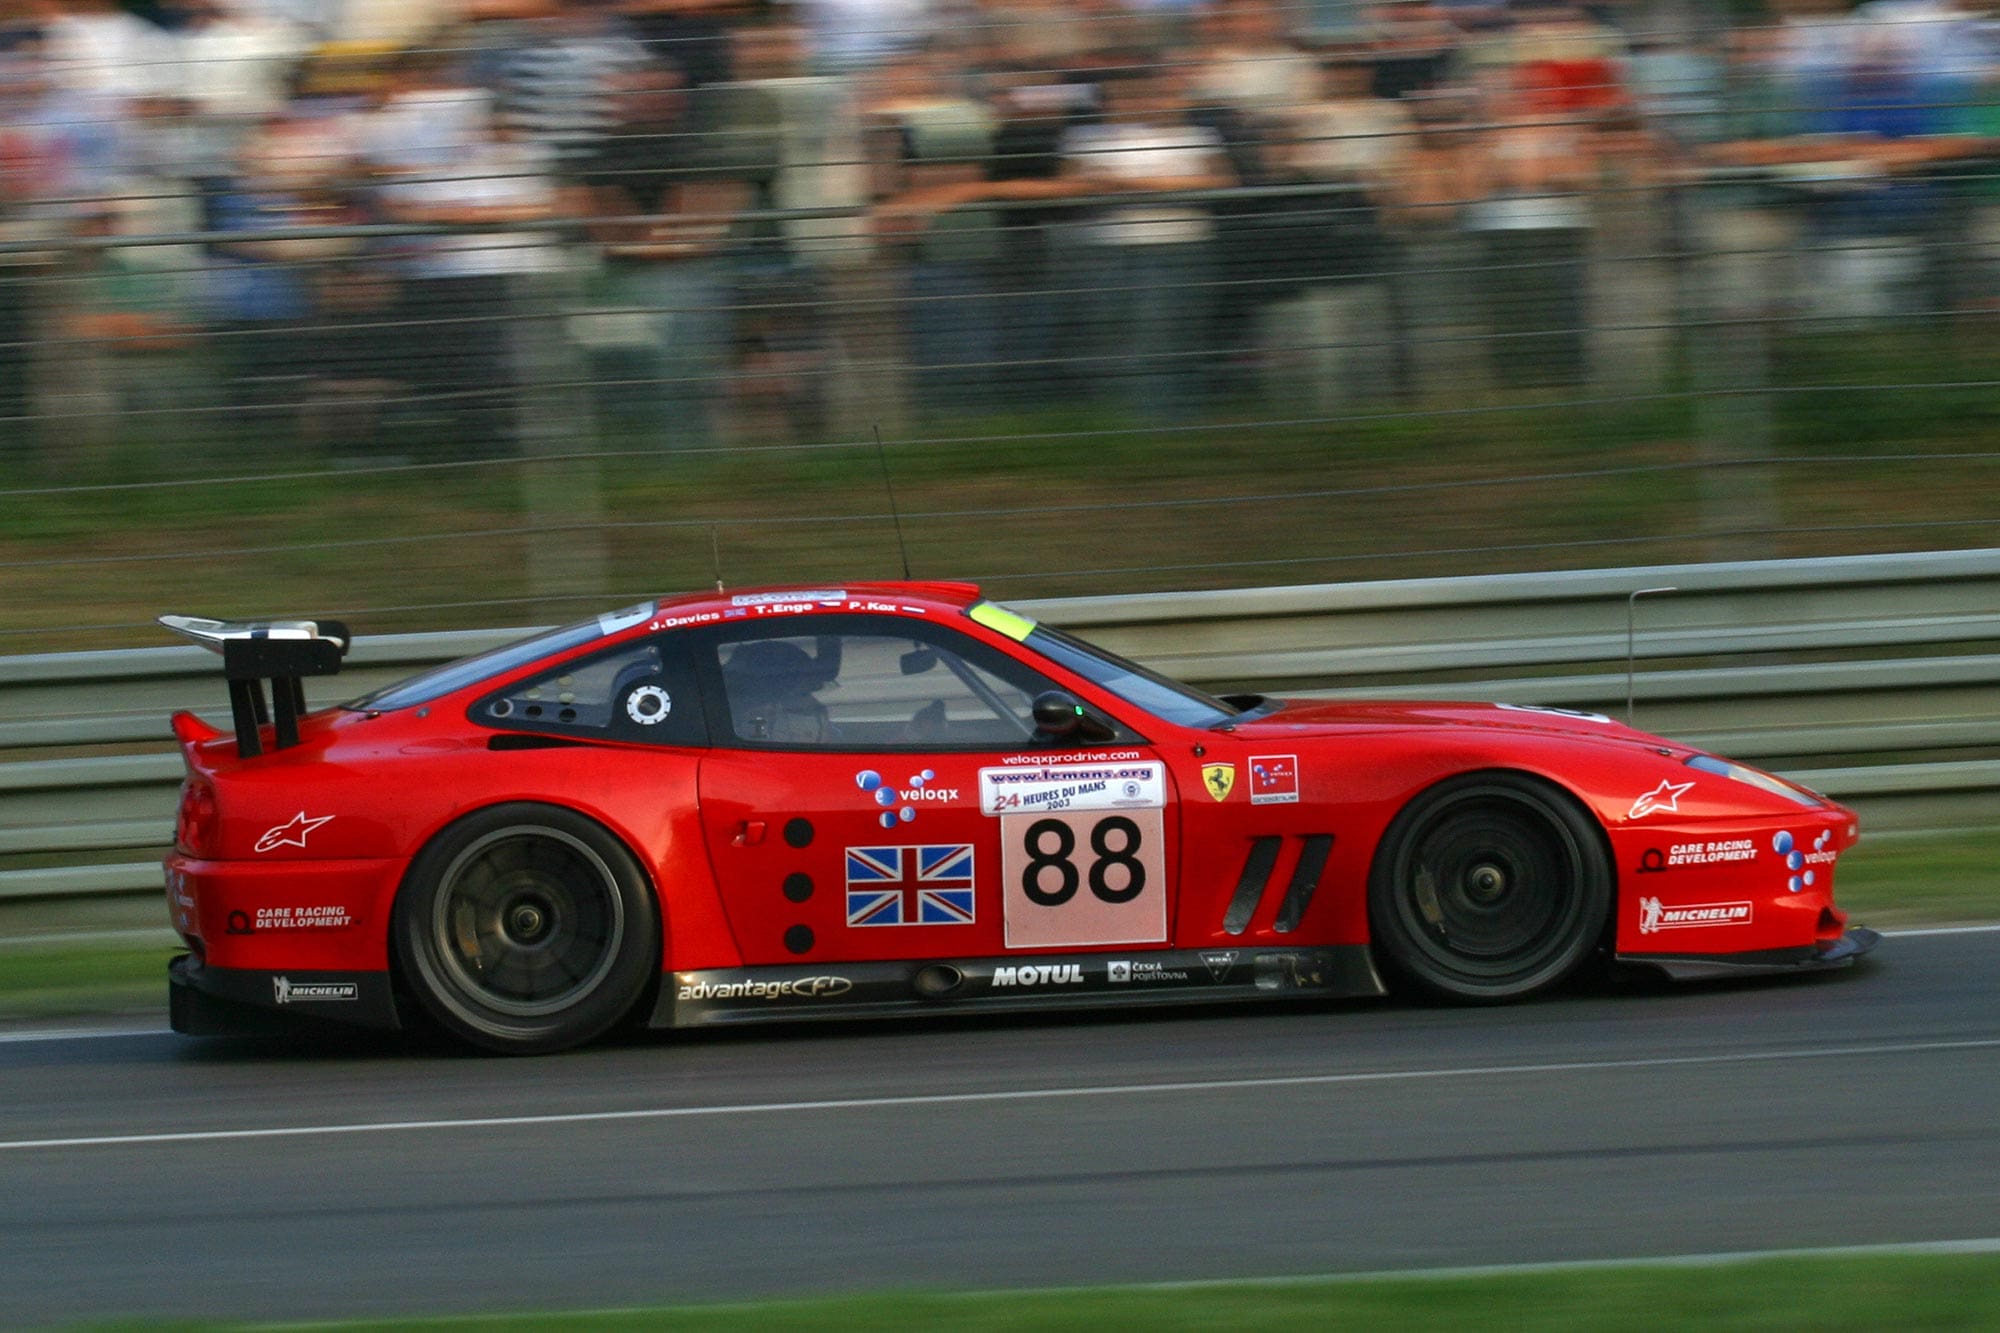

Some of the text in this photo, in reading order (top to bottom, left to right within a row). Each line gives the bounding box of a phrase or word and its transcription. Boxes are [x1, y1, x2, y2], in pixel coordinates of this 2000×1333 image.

[650, 612, 720, 630] J.Davies
[755, 602, 813, 614] T.Enge
[849, 601, 897, 612] P.Kox
[1002, 751, 1140, 766] veloqxprodrive.com
[989, 769, 1153, 784] www.lemans.org
[900, 787, 959, 803] veloqx
[994, 781, 1107, 811] 24 HEURES DU MANS
[1047, 799, 1071, 810] 2003
[1670, 840, 1752, 855] CARE RACING
[1022, 815, 1146, 907] 88
[1668, 849, 1757, 865] DEVELOPMENT
[257, 906, 345, 918] CARE RACING
[1663, 907, 1748, 922] MICHELIN
[256, 916, 351, 928] DEVELOPMENT
[992, 964, 1084, 987] MOTUL
[291, 987, 354, 996] MICHELIN
[678, 979, 793, 1001] advantage
